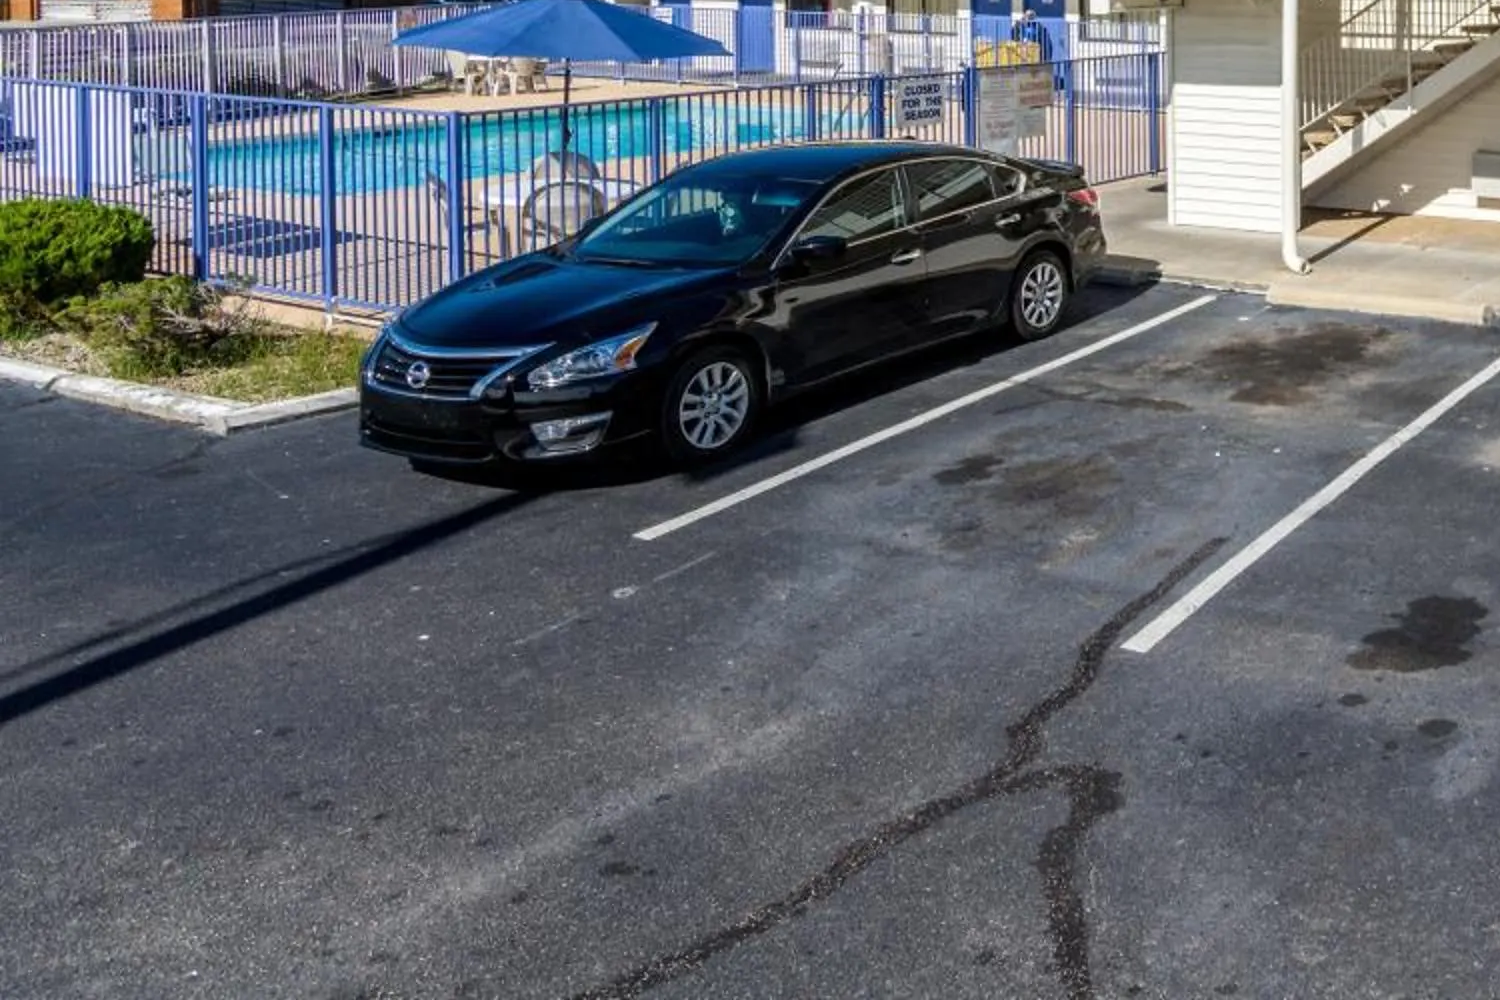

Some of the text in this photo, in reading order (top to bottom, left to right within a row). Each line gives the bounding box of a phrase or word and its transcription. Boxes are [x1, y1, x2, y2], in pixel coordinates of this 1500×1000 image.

[904, 83, 941, 97] CLOSED
[902, 95, 943, 109] FOR THE
[904, 108, 941, 121] SEASON
